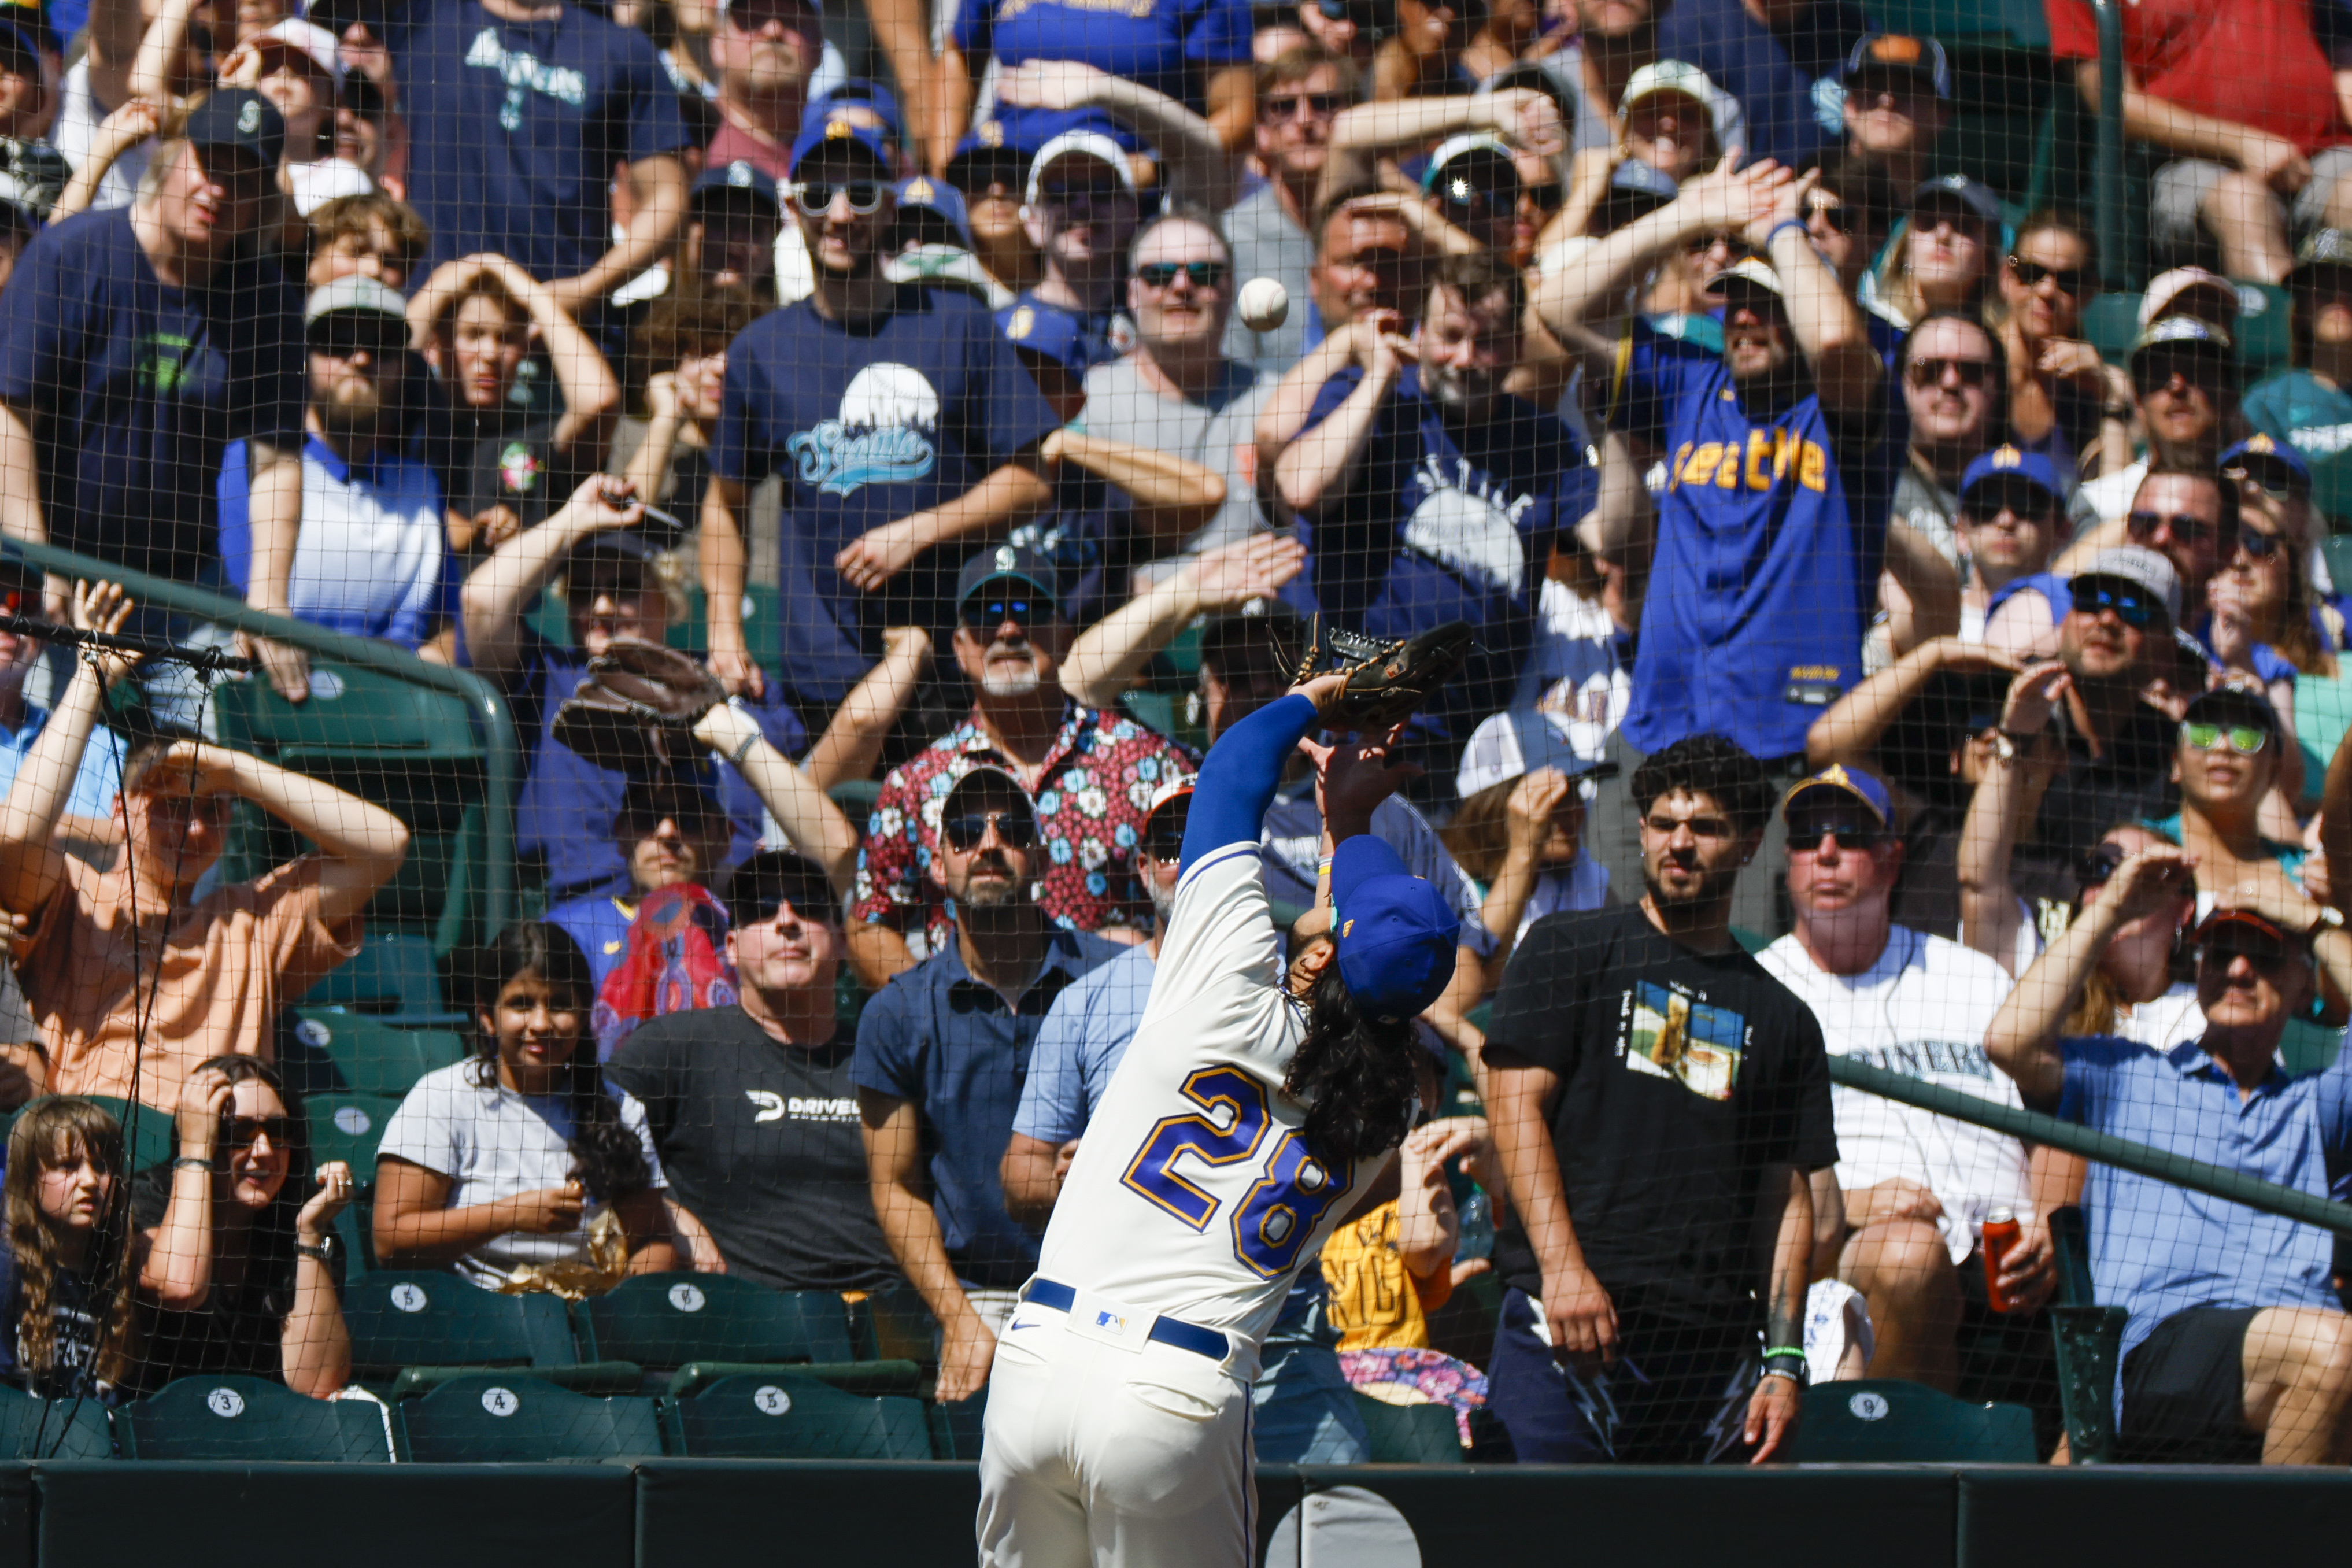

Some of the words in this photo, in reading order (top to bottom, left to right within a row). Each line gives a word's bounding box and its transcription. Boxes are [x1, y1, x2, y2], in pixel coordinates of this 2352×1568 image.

[785, 419, 933, 489] Seattle
[1119, 1063, 1356, 1281] 28
[221, 1395, 231, 1410] 3
[495, 1395, 506, 1410] 4
[767, 1393, 777, 1408] 5
[1863, 1399, 1874, 1414] 9
